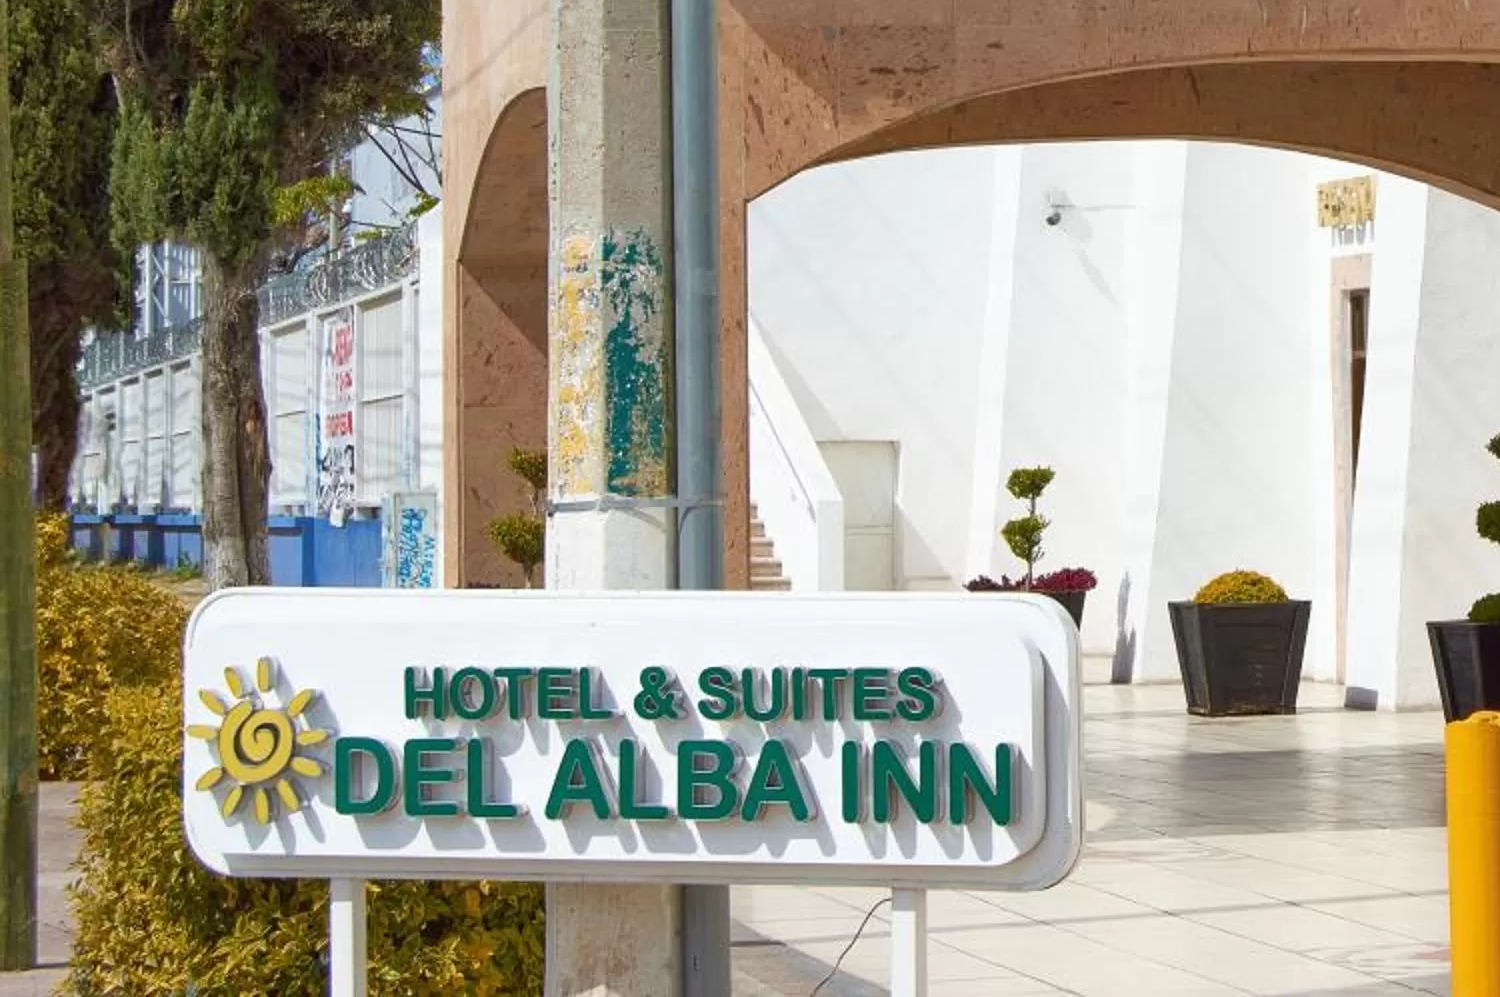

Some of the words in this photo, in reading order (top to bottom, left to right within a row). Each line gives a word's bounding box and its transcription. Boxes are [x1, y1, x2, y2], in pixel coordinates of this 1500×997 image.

[404, 666, 614, 721] HOTEL
[633, 666, 680, 720] &
[698, 666, 936, 722] SUITES
[335, 736, 518, 817] DEL
[544, 738, 809, 823] ALBA
[841, 739, 1012, 827] INN
